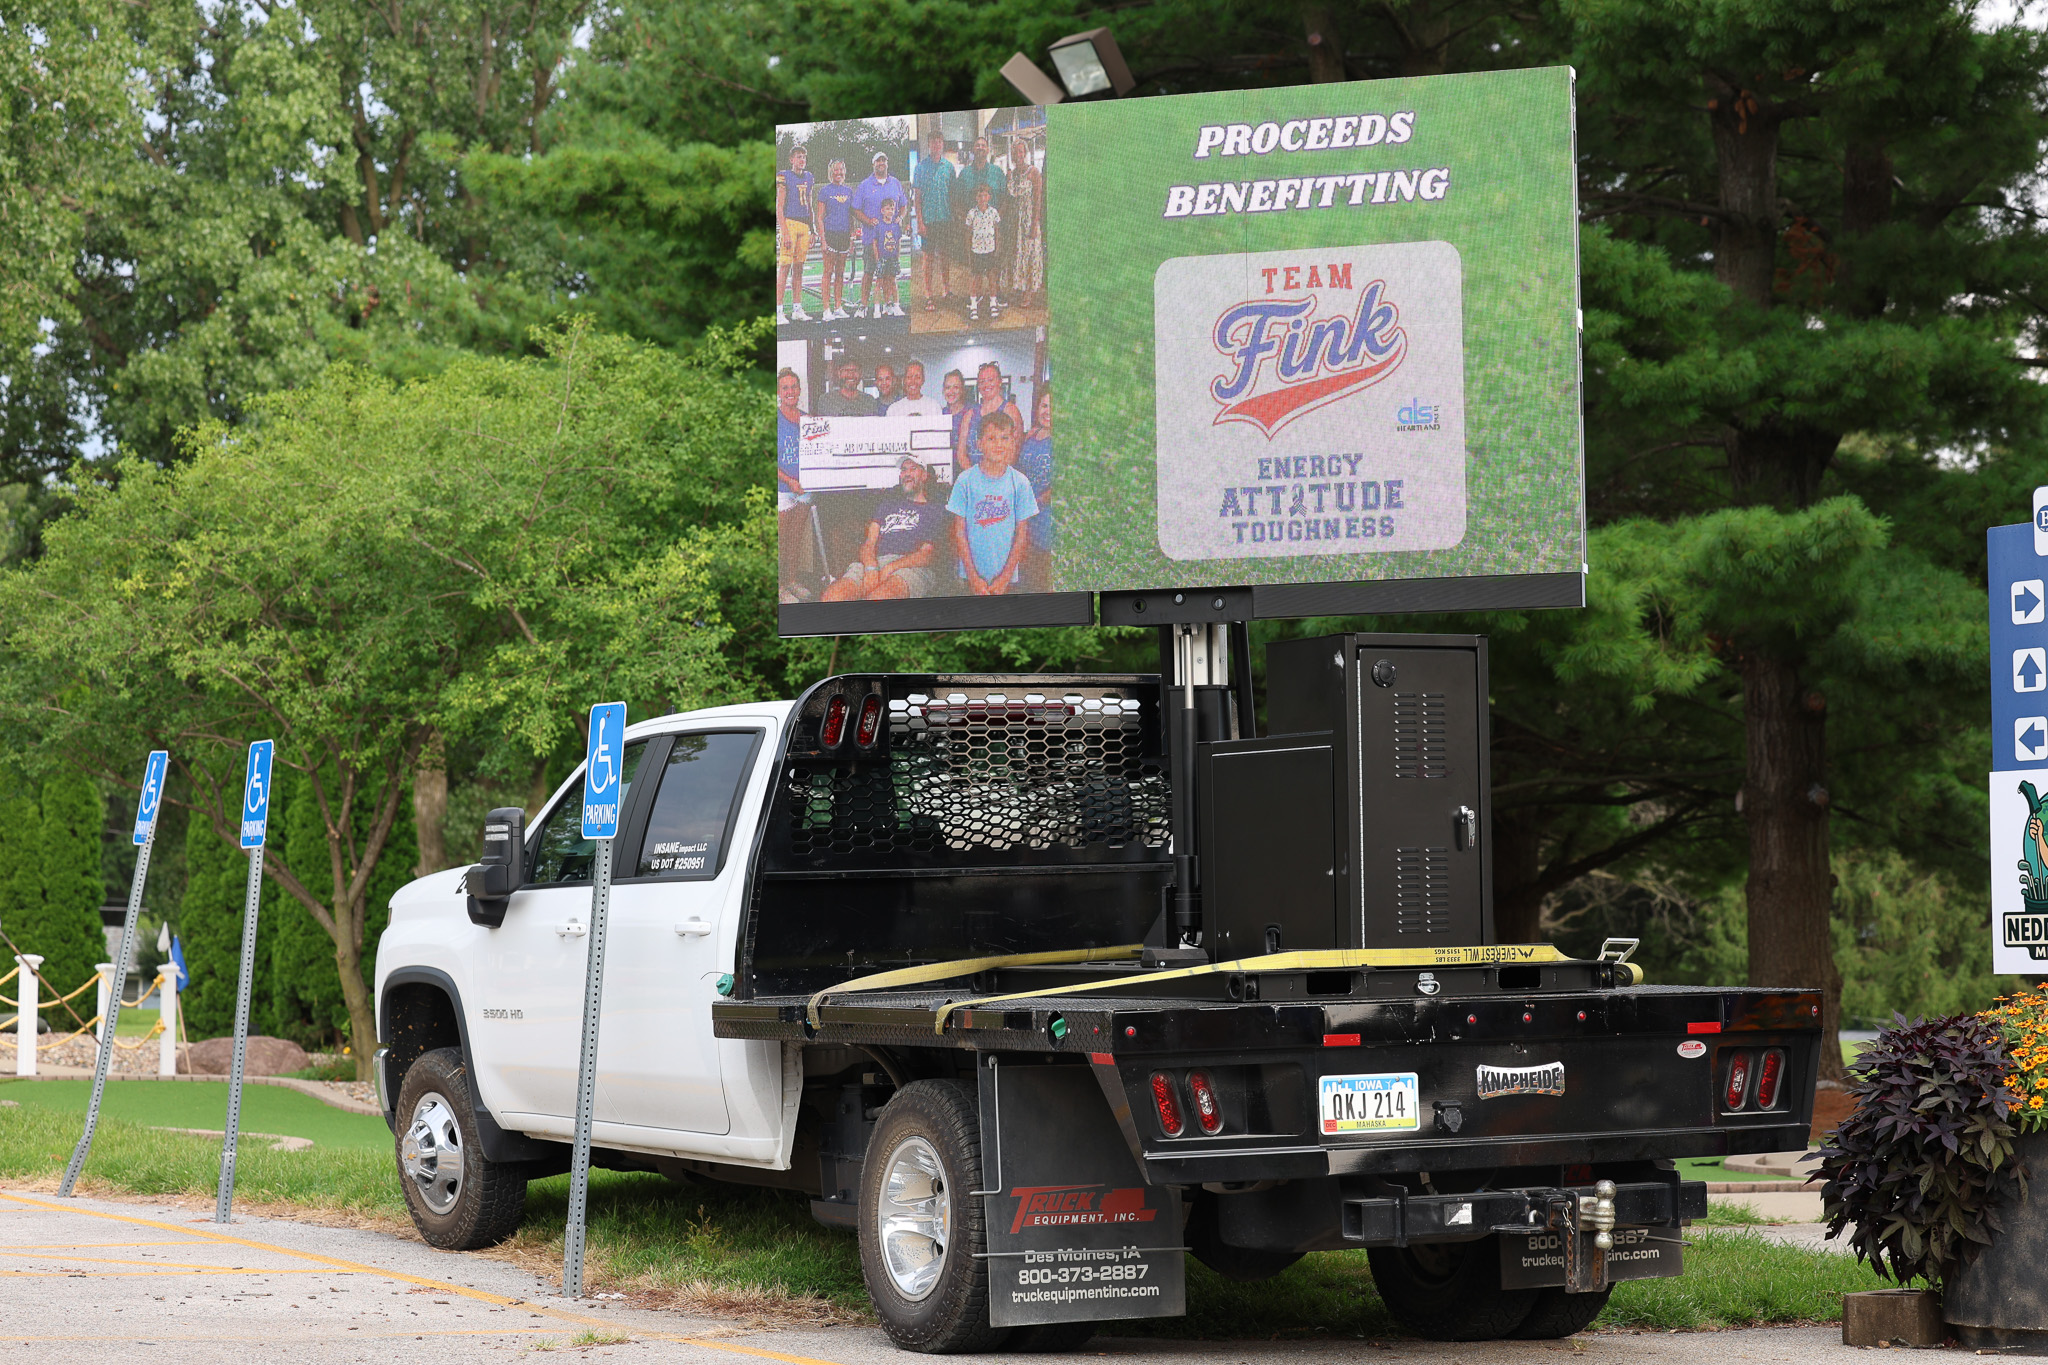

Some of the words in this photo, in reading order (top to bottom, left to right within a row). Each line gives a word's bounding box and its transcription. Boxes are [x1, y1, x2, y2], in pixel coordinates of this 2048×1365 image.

[1193, 110, 1415, 158] PROCEEDS
[1163, 168, 1449, 217] BENEFITTING
[1261, 263, 1353, 295] TEAM
[1211, 279, 1407, 404] Fink
[1257, 453, 1363, 480] ENERGY
[1232, 515, 1395, 544] TOUGHNESS
[584, 803, 616, 824] PARKING
[242, 819, 264, 837] PARKING
[653, 841, 680, 854] INSANE
[679, 844, 697, 854] impact
[696, 843, 708, 852] LLC
[651, 859, 660, 870] US
[660, 858, 674, 869] DOT
[674, 856, 705, 870] #250951
[1463, 948, 1480, 962] WLL
[1480, 947, 1516, 961] EVEREST
[483, 1008, 508, 1019] 3500
[1355, 1080, 1383, 1091] IOWA
[1481, 1067, 1561, 1094] KNAPHEIDE
[1332, 1092, 1366, 1120] QKJ
[1374, 1091, 1405, 1118] 214
[1356, 1120, 1387, 1129] MAHASKA
[1010, 1184, 1105, 1234] TRUCK
[1034, 1213, 1108, 1225] EQUIPMENT,
[1114, 1212, 1140, 1222] INC.
[1024, 1250, 1054, 1263] Des
[1057, 1248, 1120, 1263] Moines,
[1018, 1264, 1149, 1285] 800-373-2887
[1011, 1284, 1160, 1304] truckequipmentinc.com
